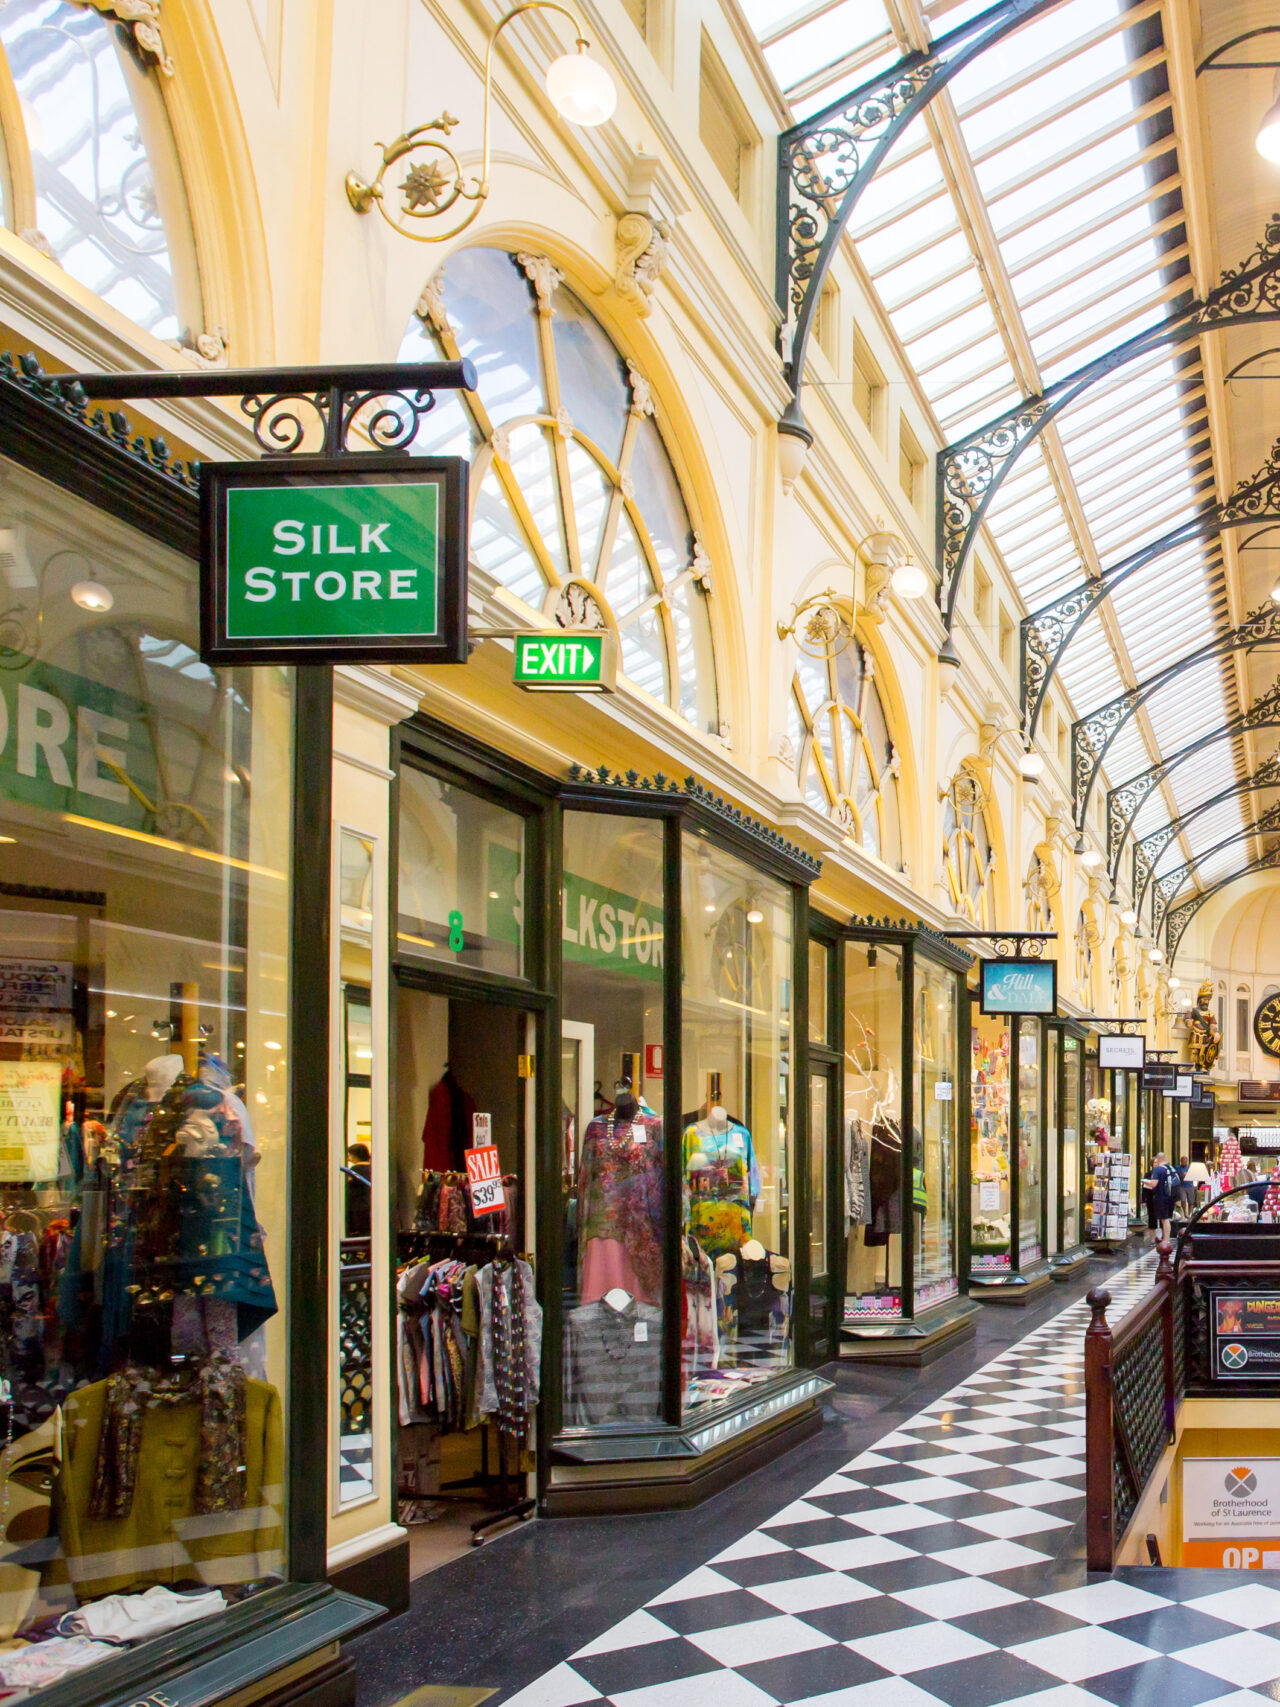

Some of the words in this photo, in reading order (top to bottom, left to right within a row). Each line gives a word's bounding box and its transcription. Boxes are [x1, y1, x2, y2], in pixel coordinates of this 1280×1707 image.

[522, 643, 582, 675] EXIT
[0, 682, 129, 805] RE
[448, 909, 464, 952] 8
[987, 984, 1007, 1001] &
[1003, 973, 1034, 991] Hill
[467, 1150, 501, 1182] SALE
[1211, 1508, 1221, 1517] of
[1233, 1509, 1273, 1518] Laurence
[1213, 1499, 1269, 1508] Brotherhood
